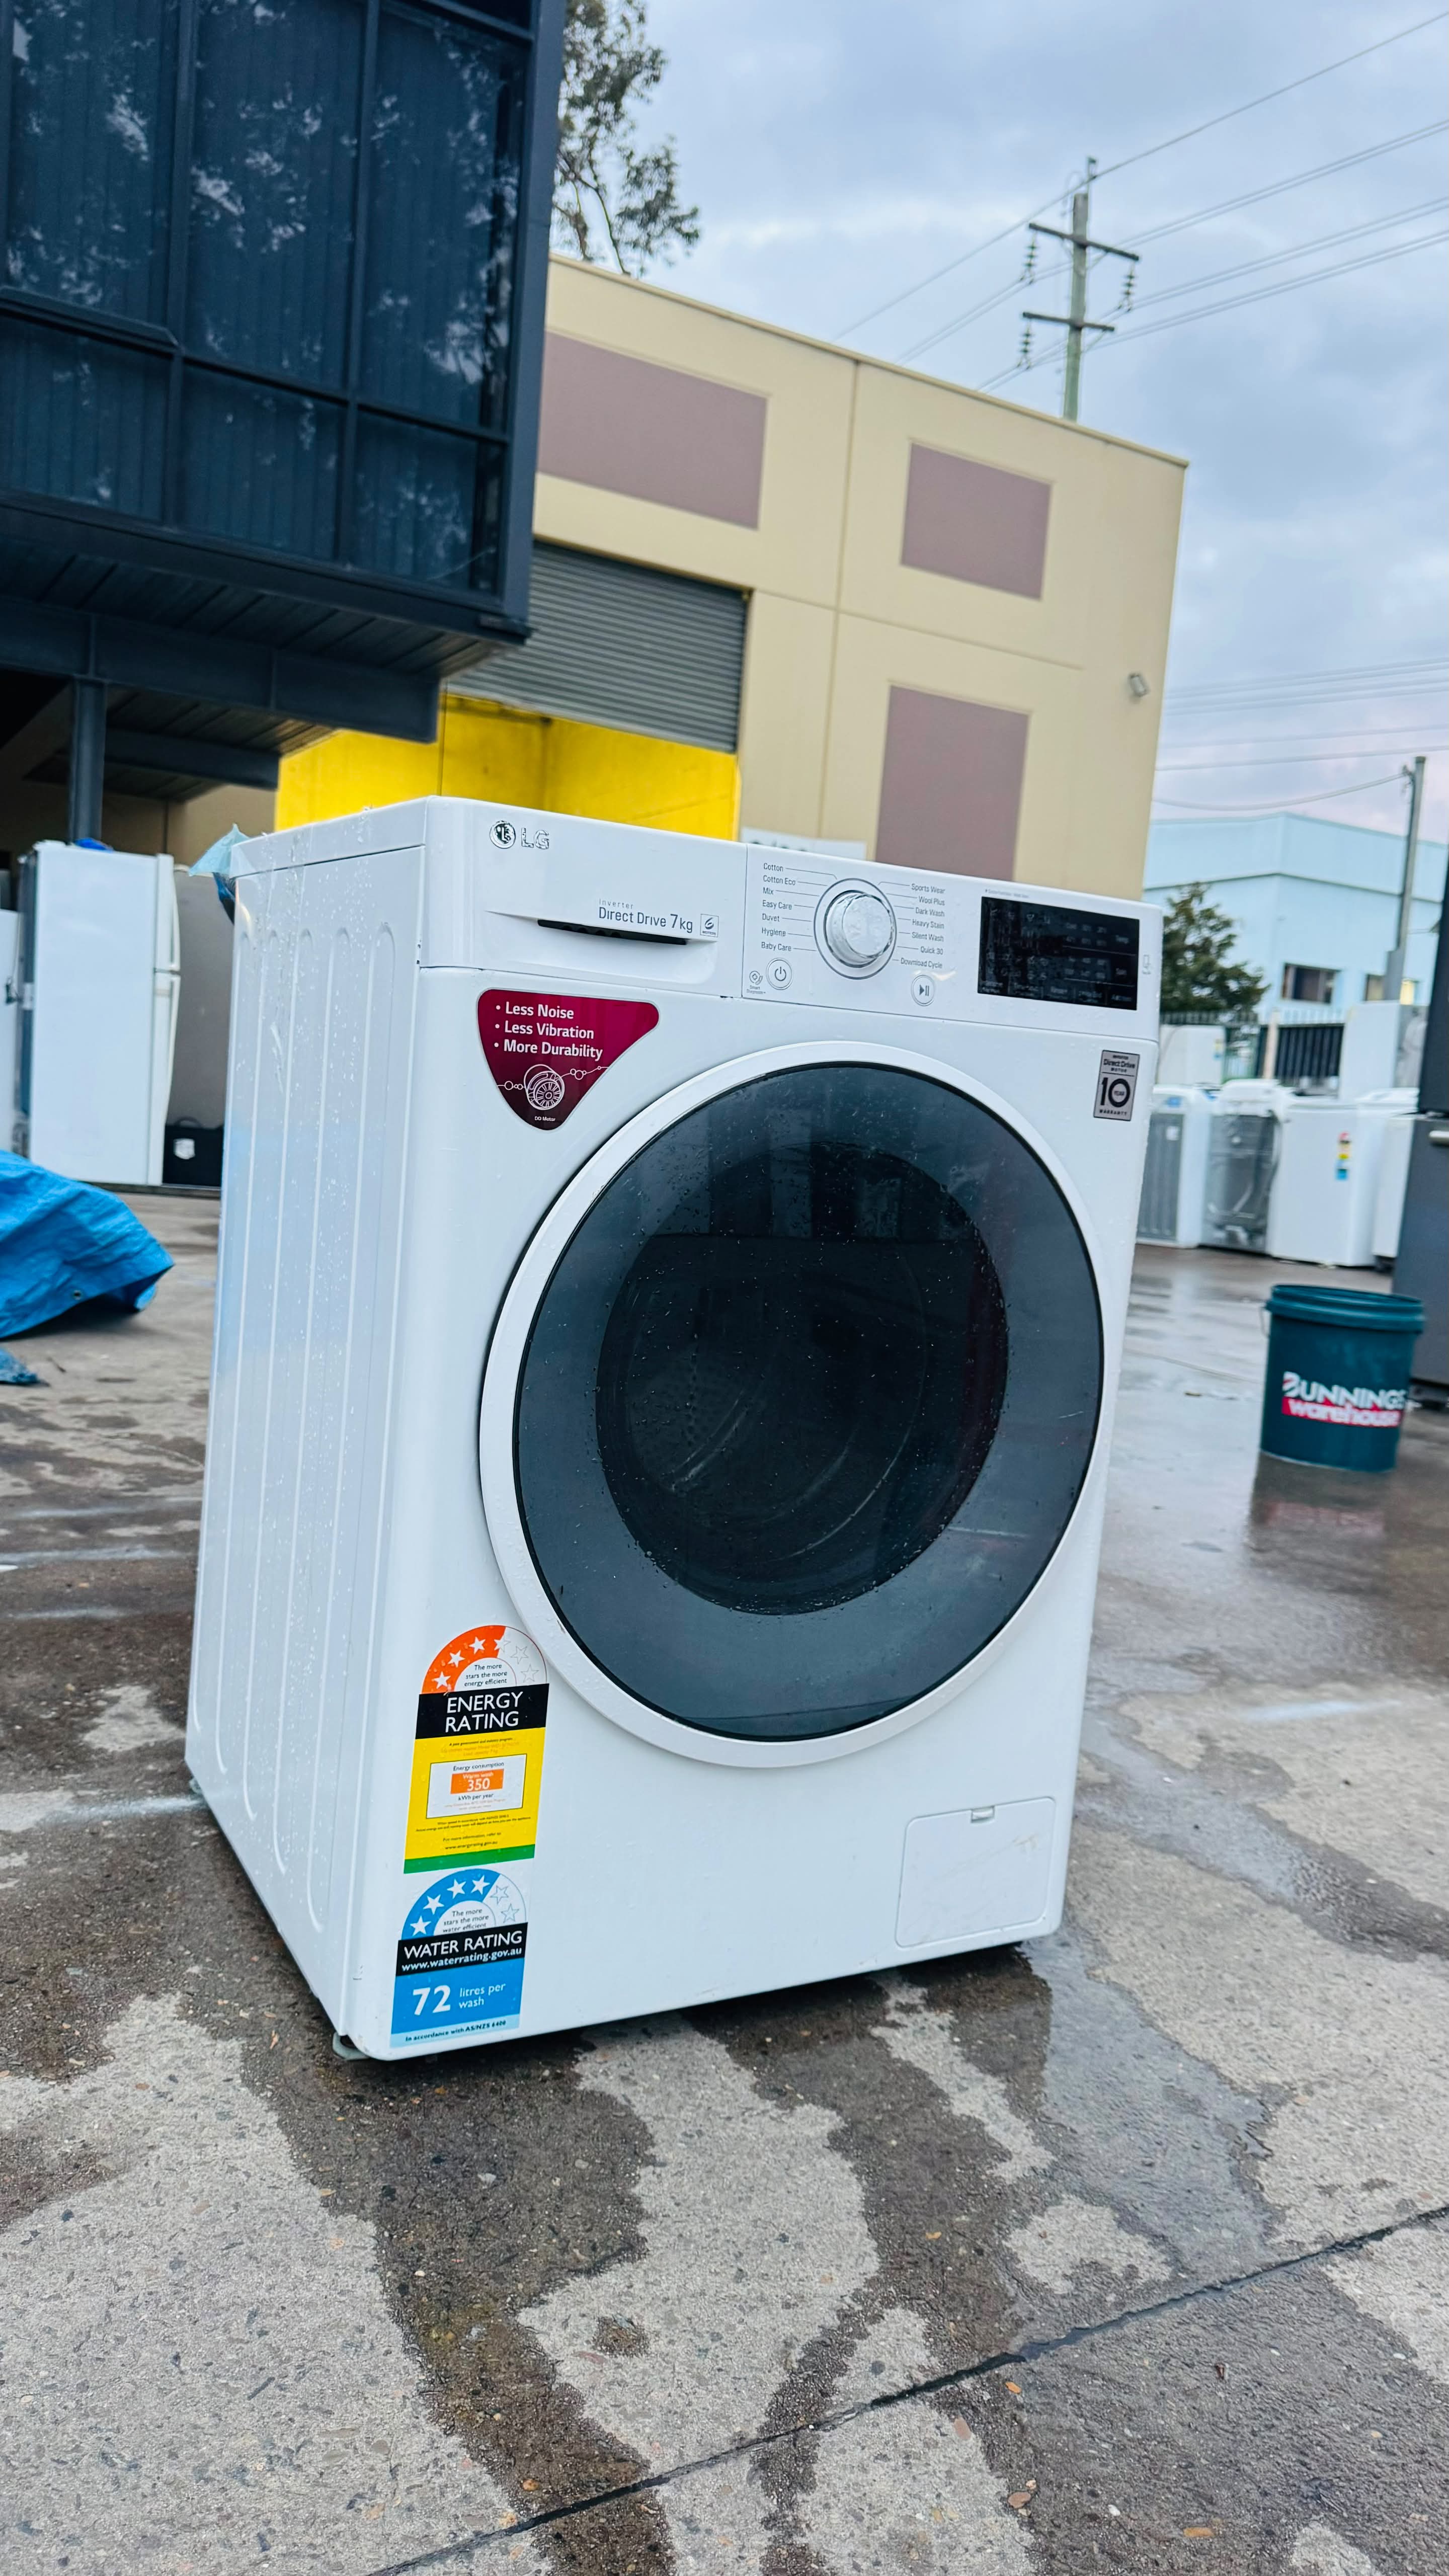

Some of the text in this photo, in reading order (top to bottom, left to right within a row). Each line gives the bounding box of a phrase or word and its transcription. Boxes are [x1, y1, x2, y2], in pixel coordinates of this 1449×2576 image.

[521, 828, 549, 849] LG
[763, 863, 783, 872] Cotton
[763, 875, 783, 884] Cotton
[911, 883, 945, 894] Sports Wear
[599, 899, 633, 909] Inverter
[762, 900, 776, 909] Easy
[919, 896, 932, 904] Wool
[599, 907, 633, 923] Direct
[637, 912, 666, 928] Drive
[762, 914, 780, 922] Duvet
[929, 909, 945, 917] Wash
[912, 919, 929, 929] Heavy
[762, 927, 786, 938] Hygiene
[912, 932, 944, 942] Silent Wash
[761, 942, 776, 951] Baby
[921, 946, 934, 954] Quick
[901, 958, 942, 969] Download Cycle
[506, 1002, 575, 1019] Less Noise
[504, 1020, 594, 1039] Less Vibration
[504, 1039, 603, 1062] More Durability
[1103, 1059, 1120, 1067] Direct
[1100, 1077, 1131, 1108] 10
[447, 1692, 523, 1714] ENERGY
[445, 1711, 519, 1733] RATING
[467, 1778, 491, 1792] 350
[404, 1930, 522, 1959] WATER RATING
[401, 1947, 522, 1971] www.waterrating.gov.au
[460, 1983, 506, 1997] litres per
[413, 1985, 451, 2016] 72
[458, 1996, 485, 2009] wash
